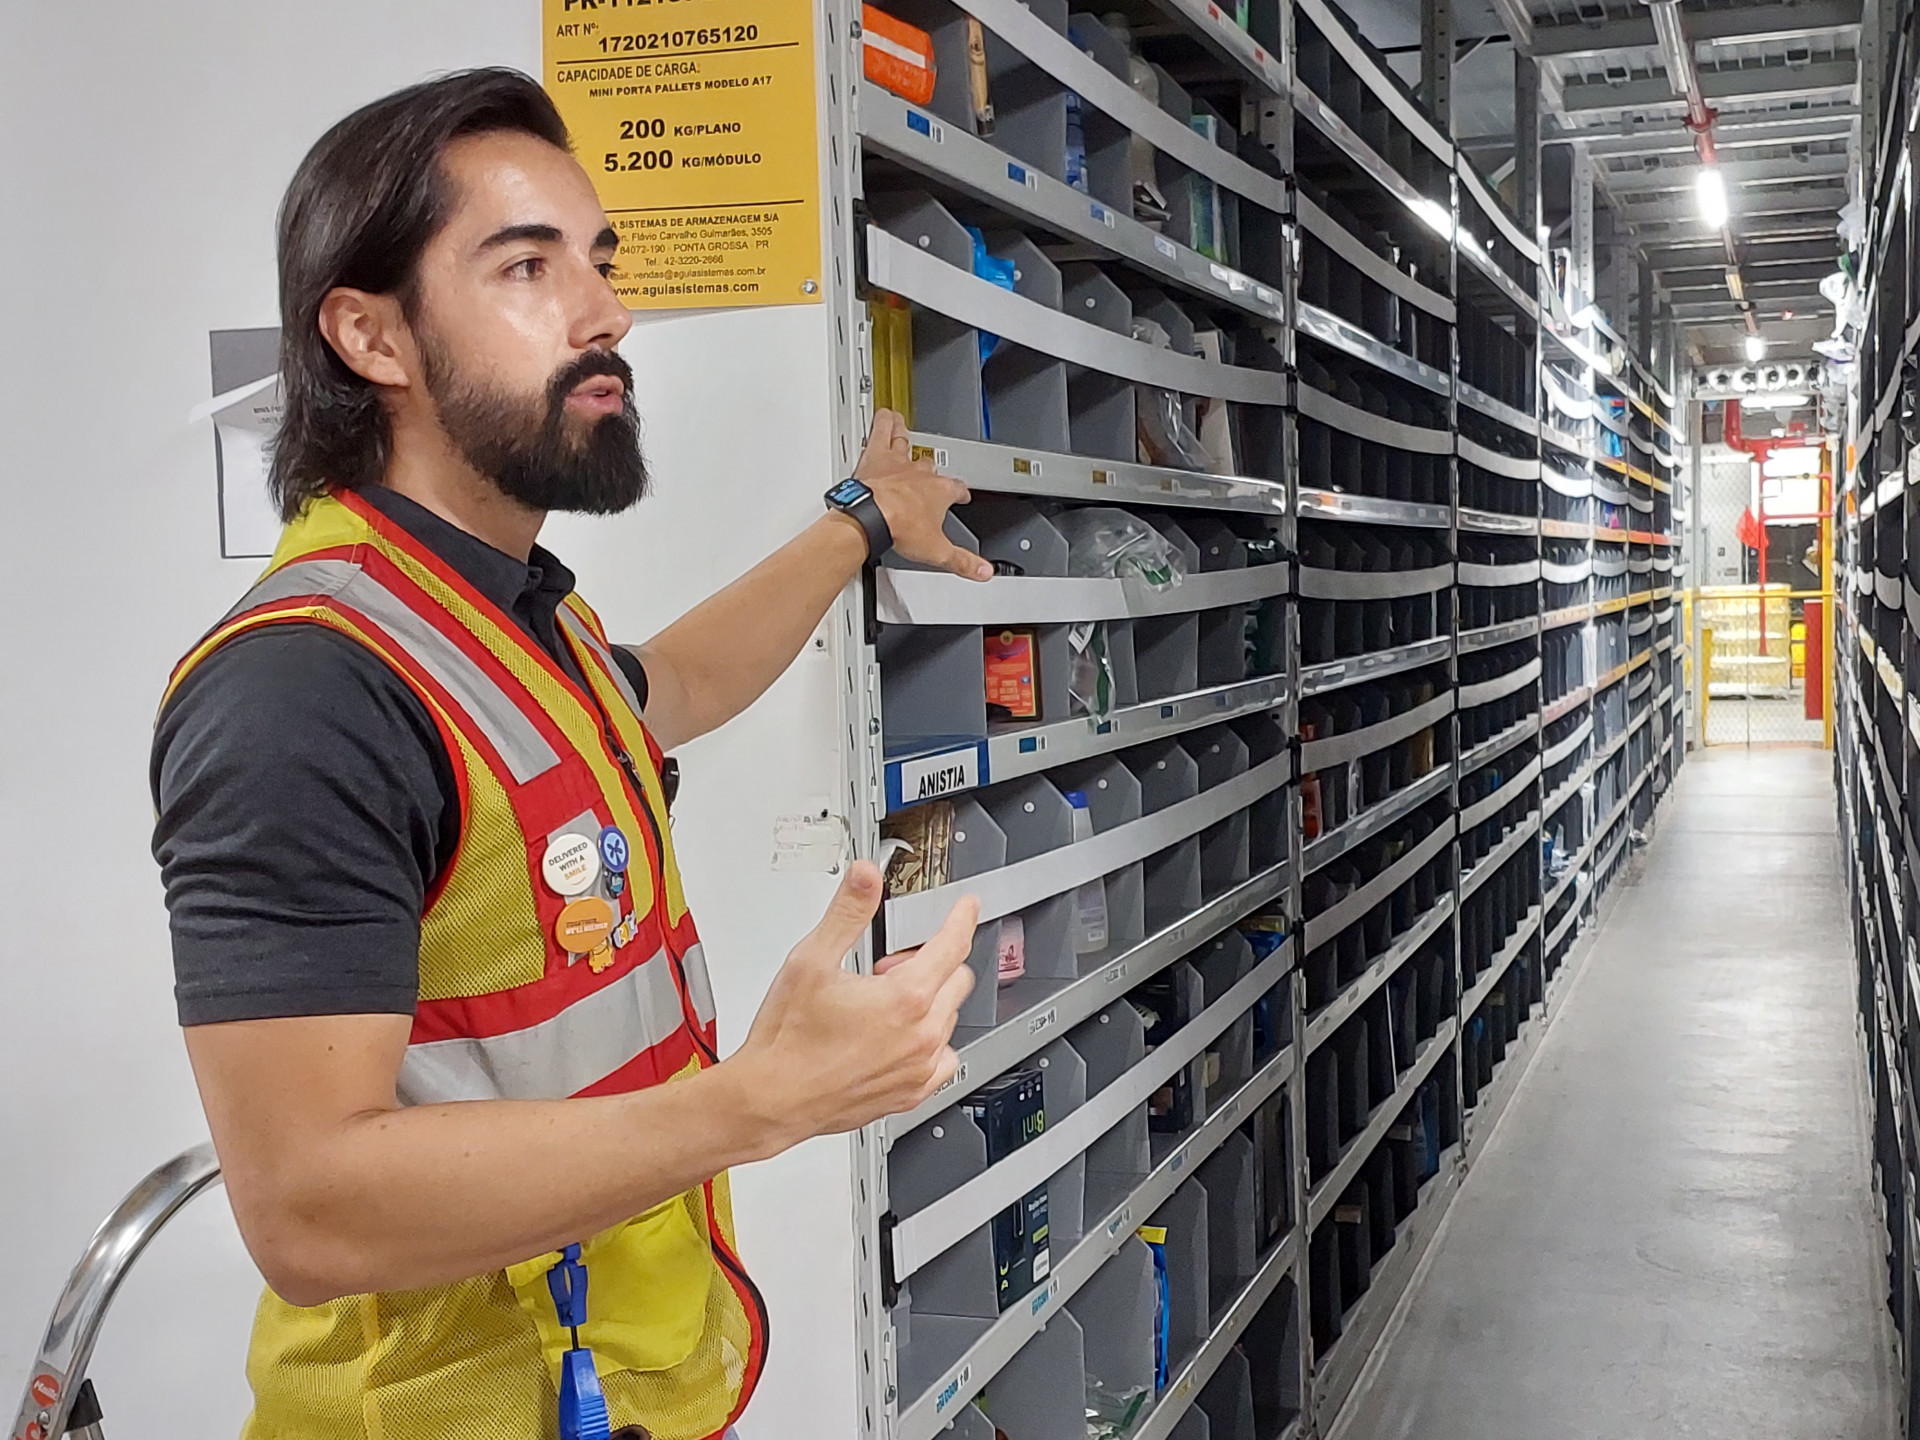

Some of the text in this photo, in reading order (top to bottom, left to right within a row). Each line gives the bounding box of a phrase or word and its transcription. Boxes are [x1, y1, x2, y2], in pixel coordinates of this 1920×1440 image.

[556, 24, 580, 37] ART
[599, 24, 758, 53] 1720210765120
[557, 65, 633, 82] CAPACIDADE
[636, 64, 652, 78] DE
[589, 76, 772, 97] MINI PORTA PALLETS MODELO A17
[620, 119, 741, 140] 200 KG/PLANO
[604, 150, 761, 172] 5.200 KG/MÓDULO
[619, 218, 667, 229] SISTEMAS
[670, 217, 683, 227] DE
[685, 215, 761, 226] ARMAZENAGEM
[763, 213, 779, 222] S/A
[632, 231, 657, 242] Flávio
[659, 228, 698, 240] Carvalho
[751, 226, 773, 237] 3505
[619, 240, 769, 255] 84072-190 PONTA GROSSA PR
[918, 764, 966, 800] ANISTIA
[548, 842, 588, 866] DELIVERED
[559, 859, 578, 872] WITH
[564, 865, 587, 880] SMILE
